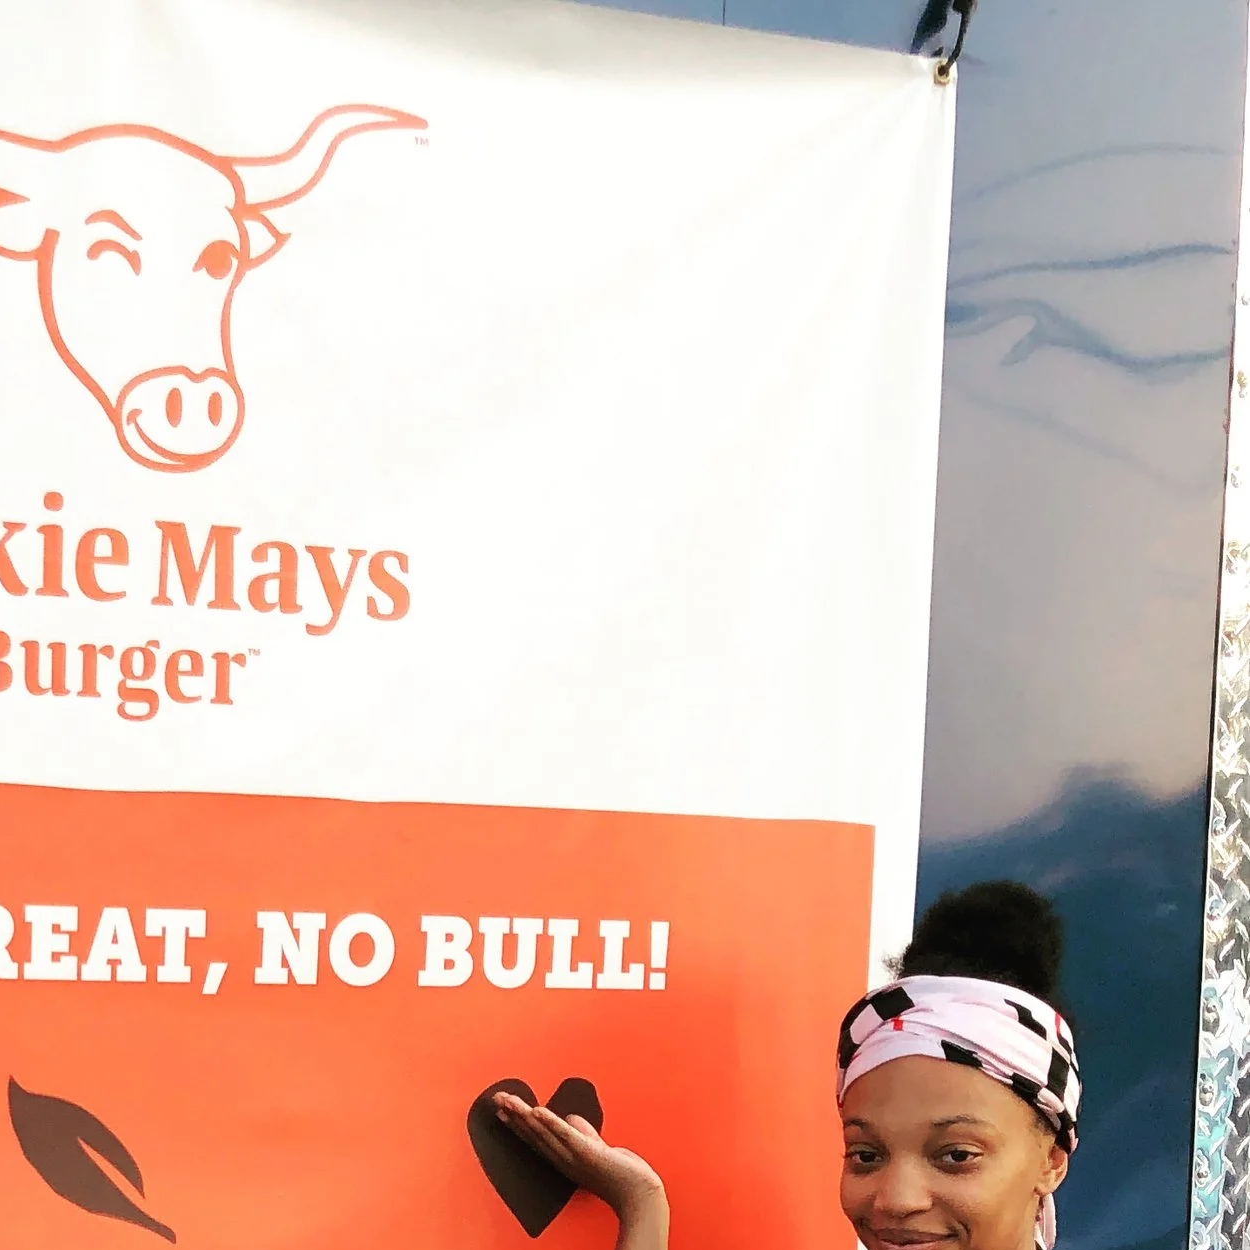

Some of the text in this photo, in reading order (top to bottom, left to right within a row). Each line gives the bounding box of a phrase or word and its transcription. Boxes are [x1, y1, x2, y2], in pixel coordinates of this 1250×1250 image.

[150, 519, 411, 637] Mays
[254, 910, 395, 987] NO
[417, 914, 670, 991] BULL!
